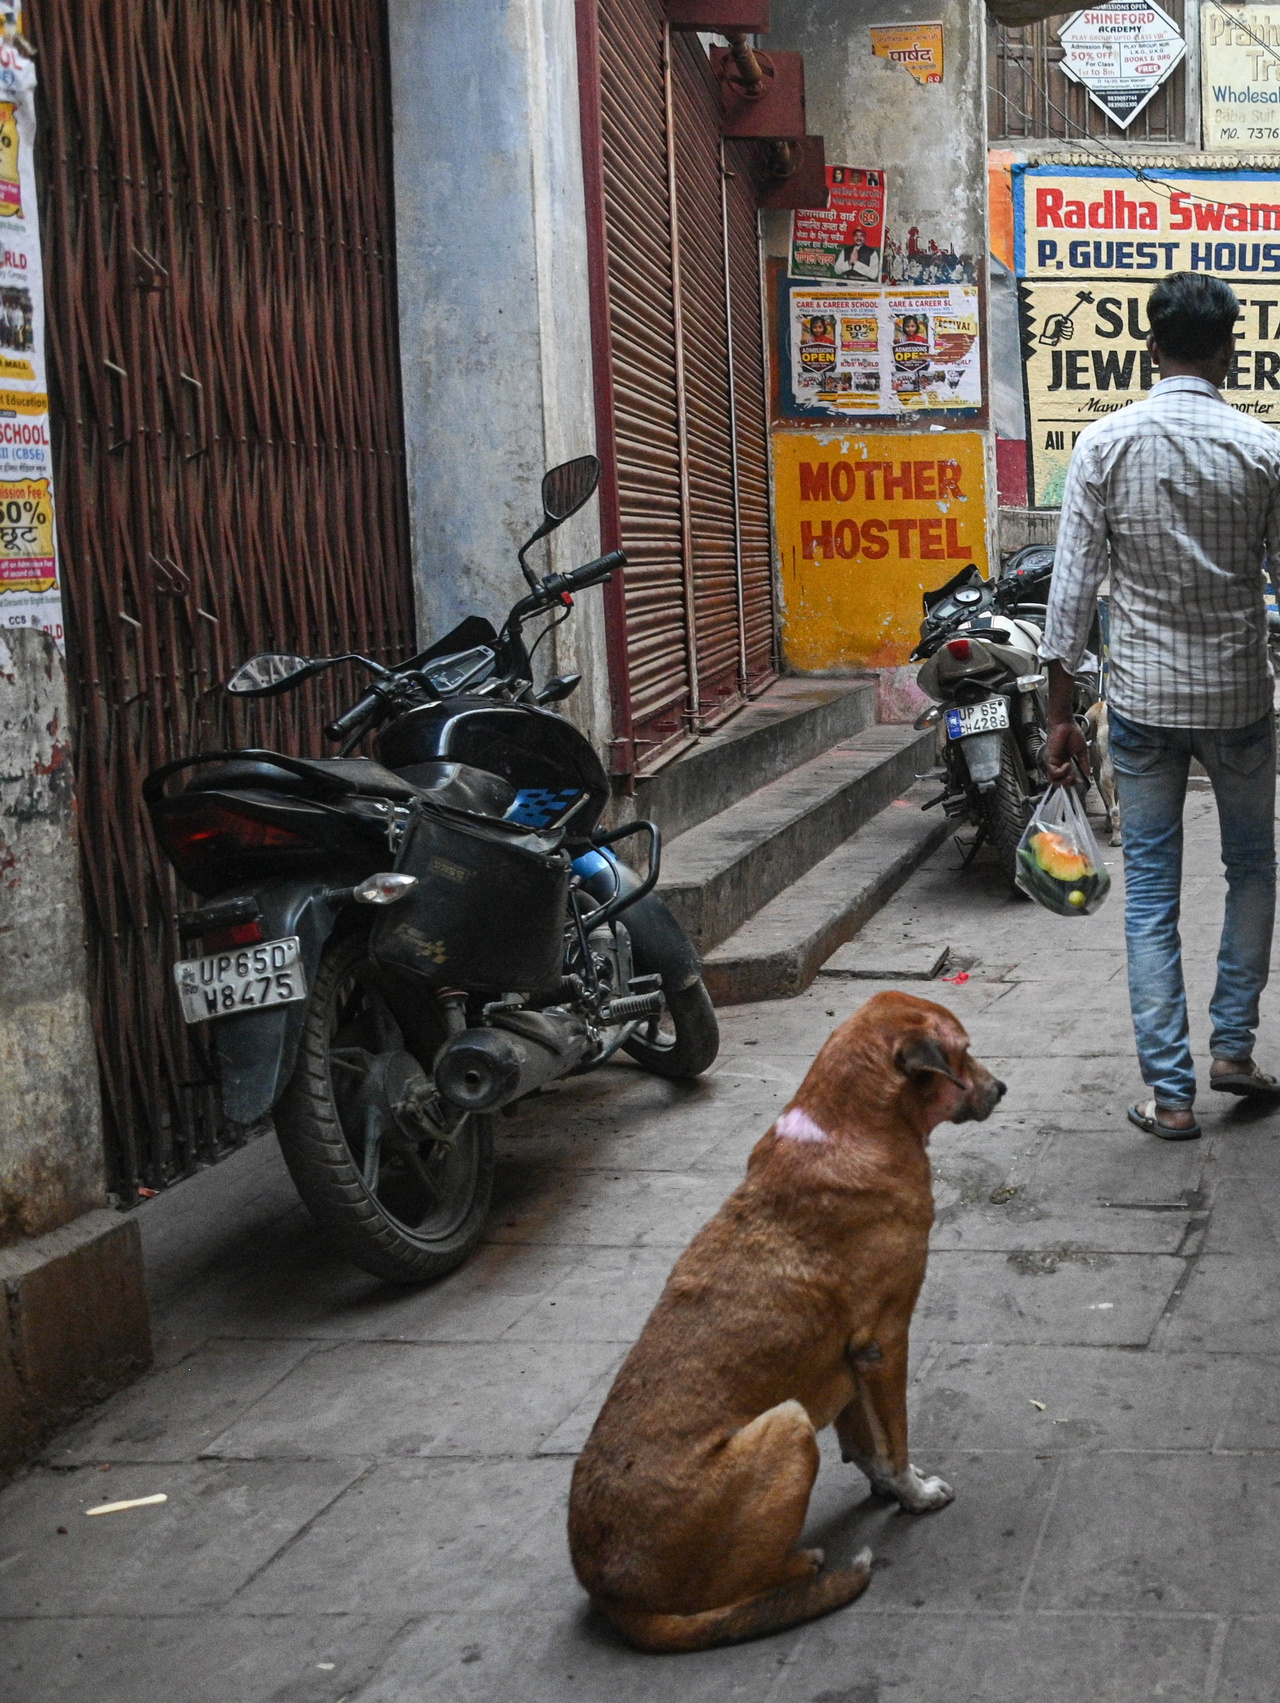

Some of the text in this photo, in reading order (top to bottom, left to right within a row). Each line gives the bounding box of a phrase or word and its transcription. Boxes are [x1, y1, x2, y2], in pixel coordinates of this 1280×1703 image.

[1084, 13, 1154, 24] SHINEFORD
[889, 44, 932, 62] पार्षद
[1071, 52, 1094, 60] 50%
[1215, 110, 1246, 123] Baba
[1252, 109, 1275, 123] Suit
[840, 210, 876, 223] वार्ड 89
[1036, 188, 1158, 230] Radha
[6, 395, 47, 408] Education
[1045, 430, 1064, 450] All
[12, 447, 44, 464] (CBSE)
[799, 460, 964, 501] MOTHER
[0, 526, 38, 551] छूट
[801, 518, 972, 560] HOSTEL
[9, 616, 26, 625] CCS
[960, 703, 997, 720] UP 65
[201, 946, 286, 986] UP65D
[204, 973, 292, 1014] W8475
